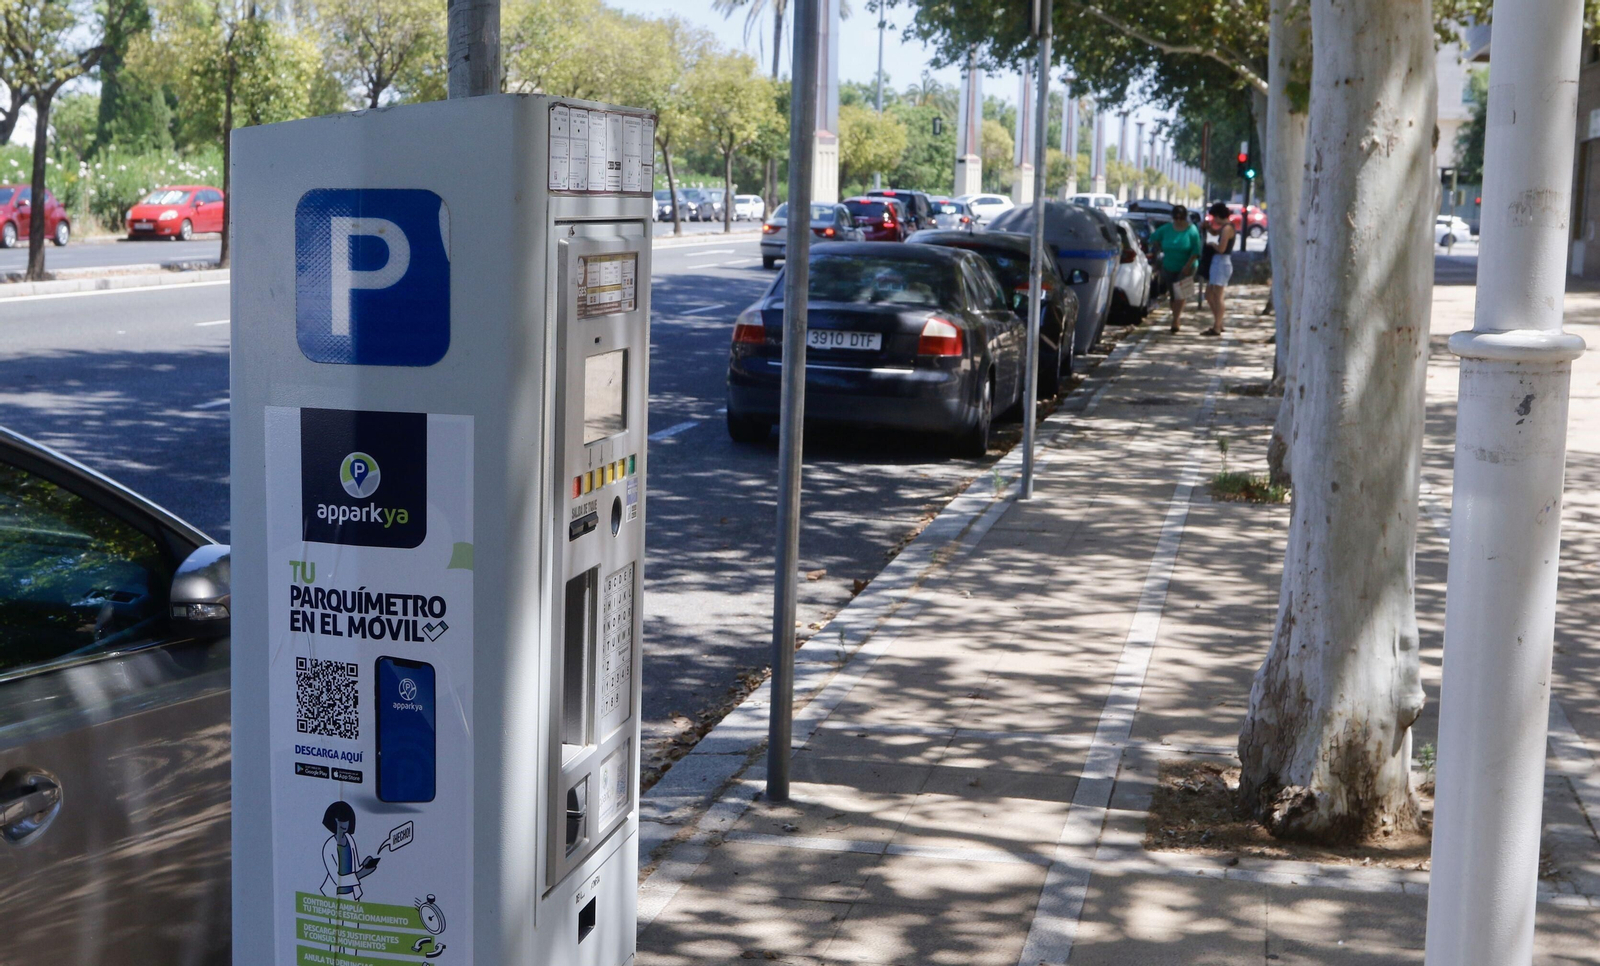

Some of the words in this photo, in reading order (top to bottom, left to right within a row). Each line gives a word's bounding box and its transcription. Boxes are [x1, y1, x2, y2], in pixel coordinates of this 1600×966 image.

[331, 216, 411, 336] P
[811, 331, 844, 346] 3910
[850, 333, 876, 348] DTF
[354, 462, 366, 478] P
[317, 502, 409, 528] apparkya
[289, 560, 316, 584] TU
[290, 585, 447, 619] PARQUÍMETRO
[290, 610, 315, 633] EN
[320, 613, 343, 636] EL
[348, 615, 424, 642] MÓVIL
[393, 702, 423, 712] apparkya
[295, 744, 339, 760] DESCARGA
[340, 751, 364, 764] AQUÍ
[303, 896, 336, 909] CONTROLA
[303, 904, 312, 912] TU
[312, 906, 336, 917] TIEMPO
[343, 911, 409, 926] ESTACIONAMIENTO
[337, 936, 387, 951] MOVIMIENTOS
[346, 931, 400, 945] JUSTIFICANTES
[304, 953, 326, 964] ANULA
